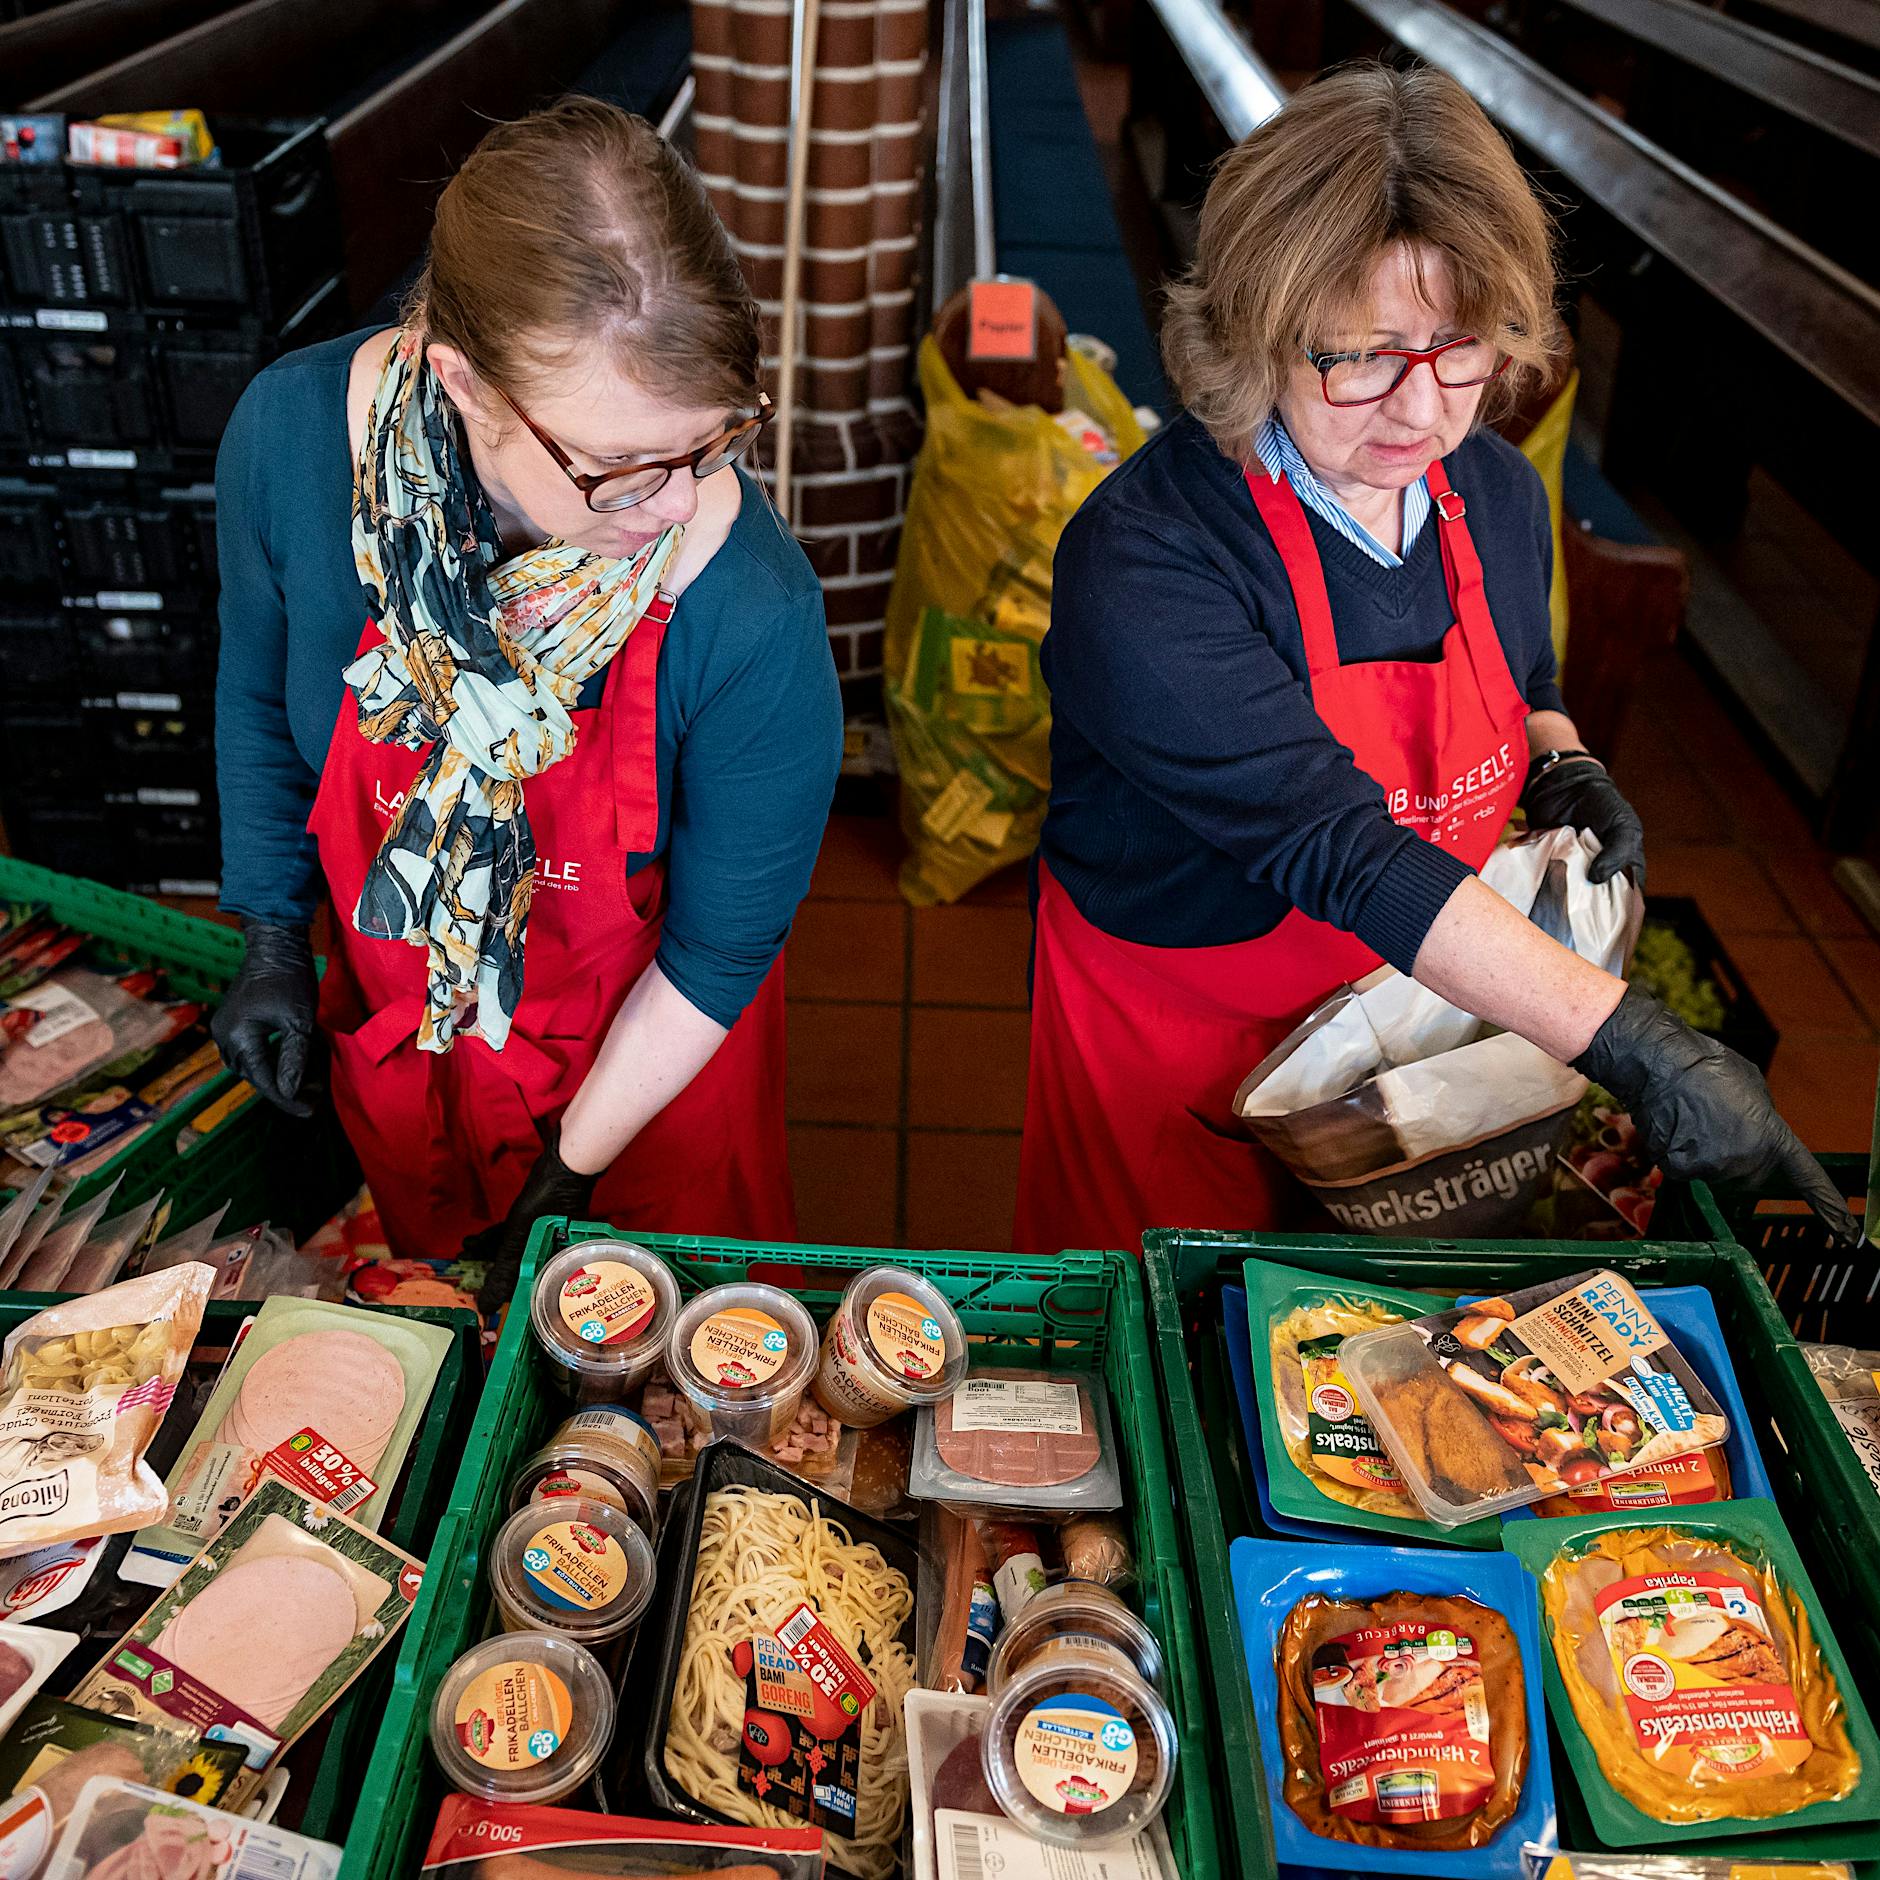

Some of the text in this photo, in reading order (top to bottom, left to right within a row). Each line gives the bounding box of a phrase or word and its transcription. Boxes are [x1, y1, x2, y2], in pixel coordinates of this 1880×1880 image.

[1388, 743, 1514, 813] IB UND SEELE
[376, 779, 405, 810] LA
[373, 802, 389, 817] Eine
[1400, 814, 1430, 825] Berliner
[1473, 805, 1497, 821] rbb
[547, 881, 562, 890] des
[564, 882, 580, 892] rbb
[593, 1278, 632, 1300] GEFLÜGEL
[568, 1282, 636, 1321] FRIKADELLEN
[597, 1286, 648, 1317] BÄLLCHEN
[610, 1302, 639, 1319] BARBECUE
[1565, 1296, 1599, 1324] MINI
[588, 1322, 601, 1330] TO
[873, 1310, 920, 1338] BÄLLCHEN
[924, 1319, 942, 1337] GO
[1580, 1288, 1647, 1348] READY
[581, 1328, 604, 1341] GO
[704, 1325, 759, 1349] BÄLLCHEN
[768, 1332, 787, 1348] GO
[879, 1321, 941, 1357] FRIKADELLEN
[923, 1327, 934, 1338] TO
[1553, 1303, 1615, 1366] SCHNITZEL
[706, 1343, 743, 1361] GEFLÜGEL
[707, 1335, 777, 1367] FRIKADELLEN
[763, 1338, 775, 1349] TO
[828, 1337, 892, 1411] FRIKADELLEN
[1625, 1378, 1645, 1401] HEISS
[1648, 1408, 1668, 1433] KALT
[1665, 1373, 1696, 1420] TO HEAT
[16, 1404, 85, 1421] Formaggi
[41, 1408, 113, 1430] Prosciutto
[1671, 1409, 1687, 1429] HITZE
[1329, 1423, 1355, 1431] Joghurt,
[1316, 1433, 1379, 1452] nsteaks
[300, 1456, 337, 1495] billiger.
[1689, 1460, 1700, 1472] 2
[1, 1483, 63, 1512] hilcona
[1614, 1495, 1667, 1505] MÜHLENBRINK
[524, 1549, 543, 1570] GO
[538, 1553, 550, 1567] TO
[543, 1534, 608, 1588] FRIKADELLEN
[576, 1551, 612, 1582] GEFLÜGEL
[556, 1557, 607, 1601] BÄLLCHEN
[556, 1570, 589, 1599] KÖTTBULLAR
[1645, 1573, 1697, 1587] Paprika
[1356, 1624, 1426, 1643] BARBECUE
[807, 1634, 847, 1684] billiger.
[760, 1667, 785, 1685] BAMI
[495, 1680, 506, 1727] GEFLÜGEL
[515, 1667, 529, 1732] BÄLLCHEN
[530, 1679, 538, 1721] CHILI-CHEESE
[761, 1683, 811, 1710] GORENG
[1678, 1691, 1712, 1701] glutenfrei
[1652, 1704, 1680, 1713] Joghurt,
[503, 1678, 519, 1763] FRIKADELLEN
[1639, 1710, 1800, 1736] Hähnchensteaks
[531, 1732, 543, 1747] TO
[1023, 1729, 1097, 1753] BÄLLCHEN
[1103, 1735, 1117, 1748] TO
[1104, 1722, 1134, 1742] GO
[1363, 1731, 1444, 1749] gewürzt & mariniert
[536, 1732, 554, 1758] GO
[1031, 1743, 1127, 1774] FRIKADELLEN
[1031, 1754, 1083, 1773] GEFLÜGEL
[1329, 1745, 1480, 1777] 2 Hähncheneaks
[836, 1787, 856, 1805] HEAT
[1348, 1787, 1363, 1796] AUCH
[489, 1825, 524, 1842] 500
